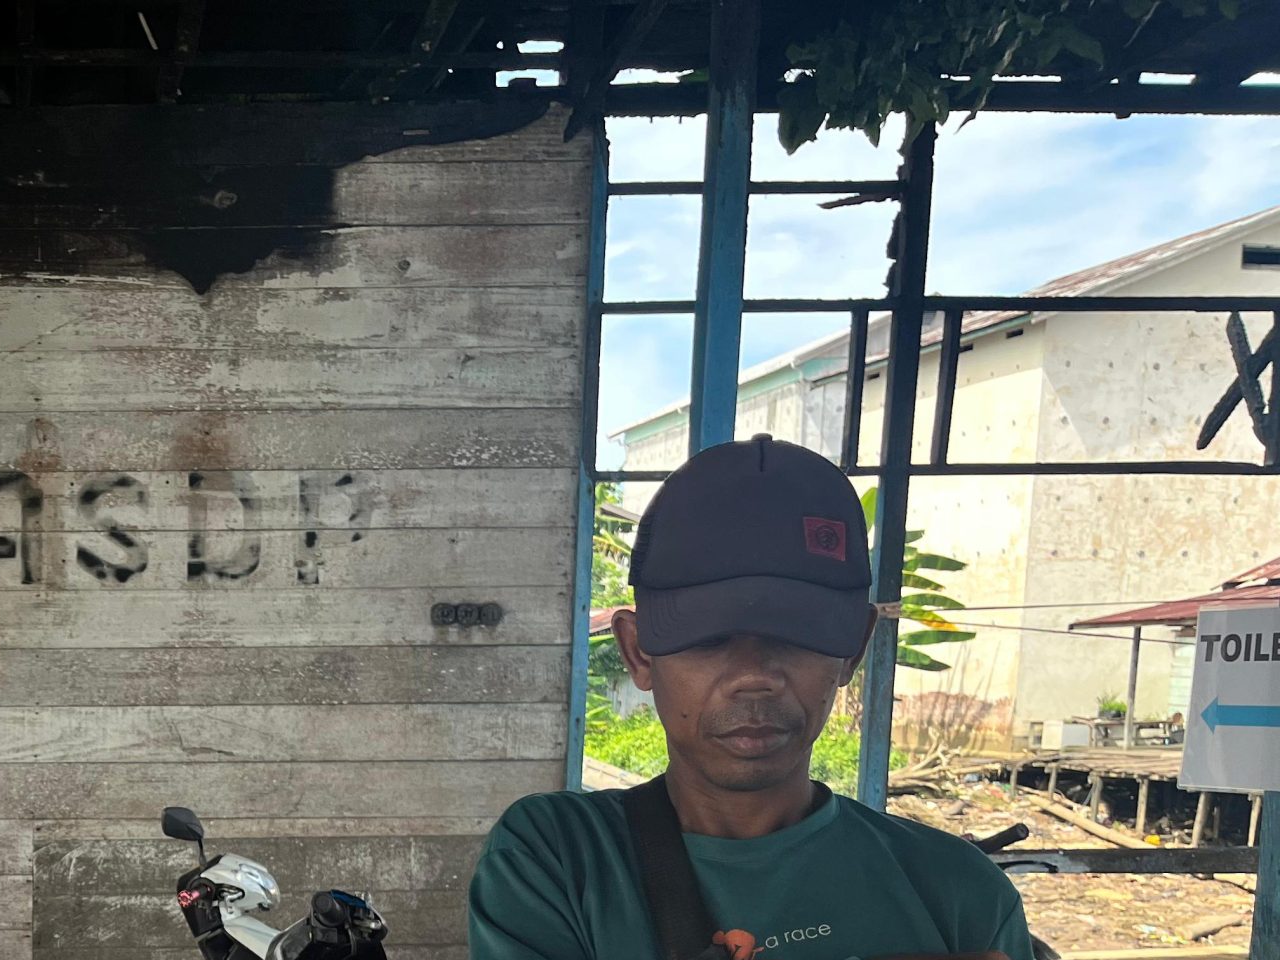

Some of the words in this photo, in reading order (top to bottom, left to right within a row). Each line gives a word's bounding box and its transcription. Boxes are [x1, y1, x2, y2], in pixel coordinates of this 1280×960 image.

[1201, 633, 1280, 662] TOILE
[765, 935, 779, 949] a
[784, 923, 831, 943] race
